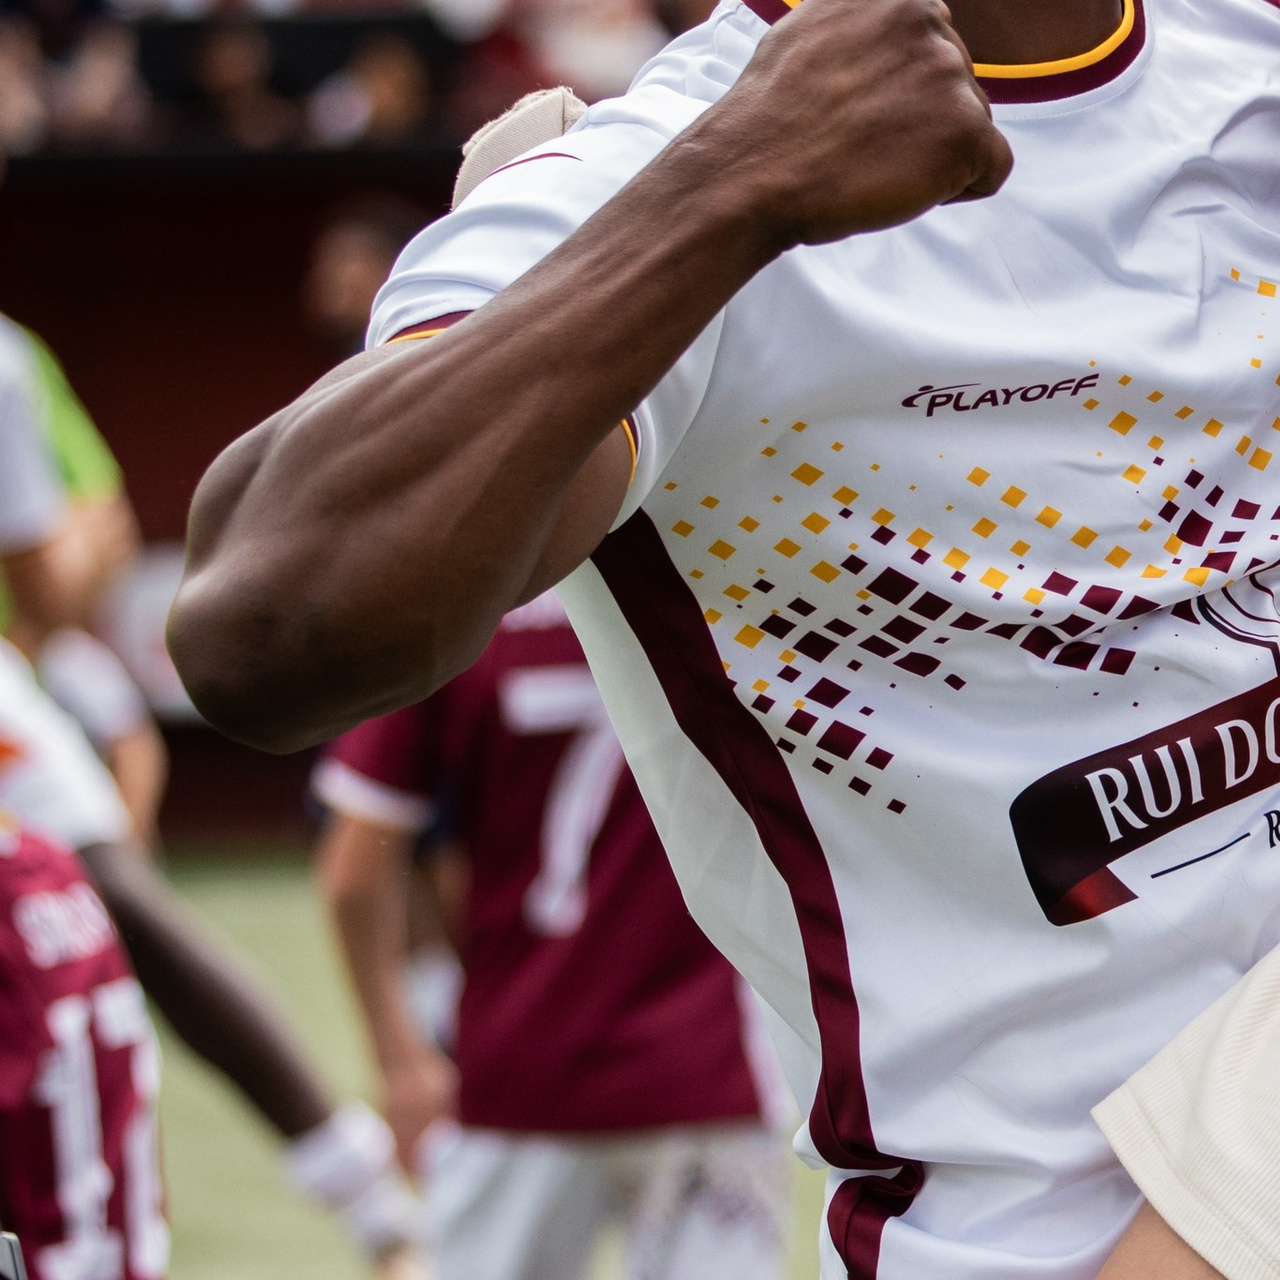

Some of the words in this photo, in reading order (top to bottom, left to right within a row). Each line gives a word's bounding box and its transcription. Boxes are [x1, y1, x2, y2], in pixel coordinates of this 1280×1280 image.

[924, 373, 1100, 417] PLAYOFF
[500, 666, 625, 937] 7
[1085, 736, 1205, 845] RUI
